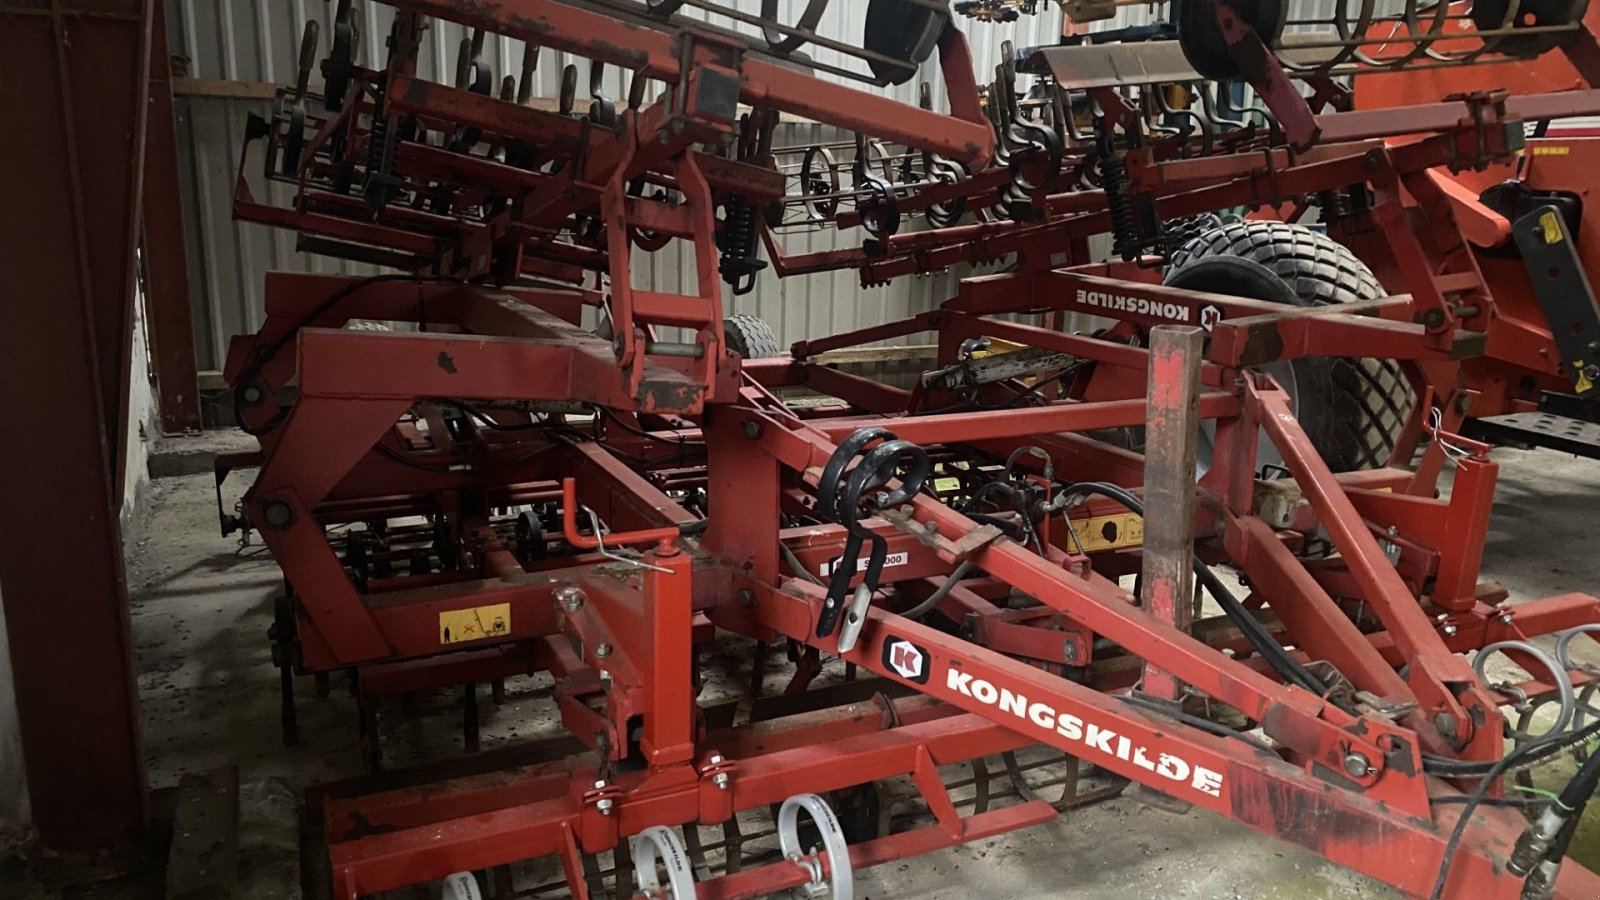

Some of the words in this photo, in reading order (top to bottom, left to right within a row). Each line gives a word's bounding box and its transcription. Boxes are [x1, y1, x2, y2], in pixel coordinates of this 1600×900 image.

[1076, 290, 1190, 321] KONGSKILDE
[893, 645, 918, 674] K
[947, 668, 1223, 798] KONGSKILDE
